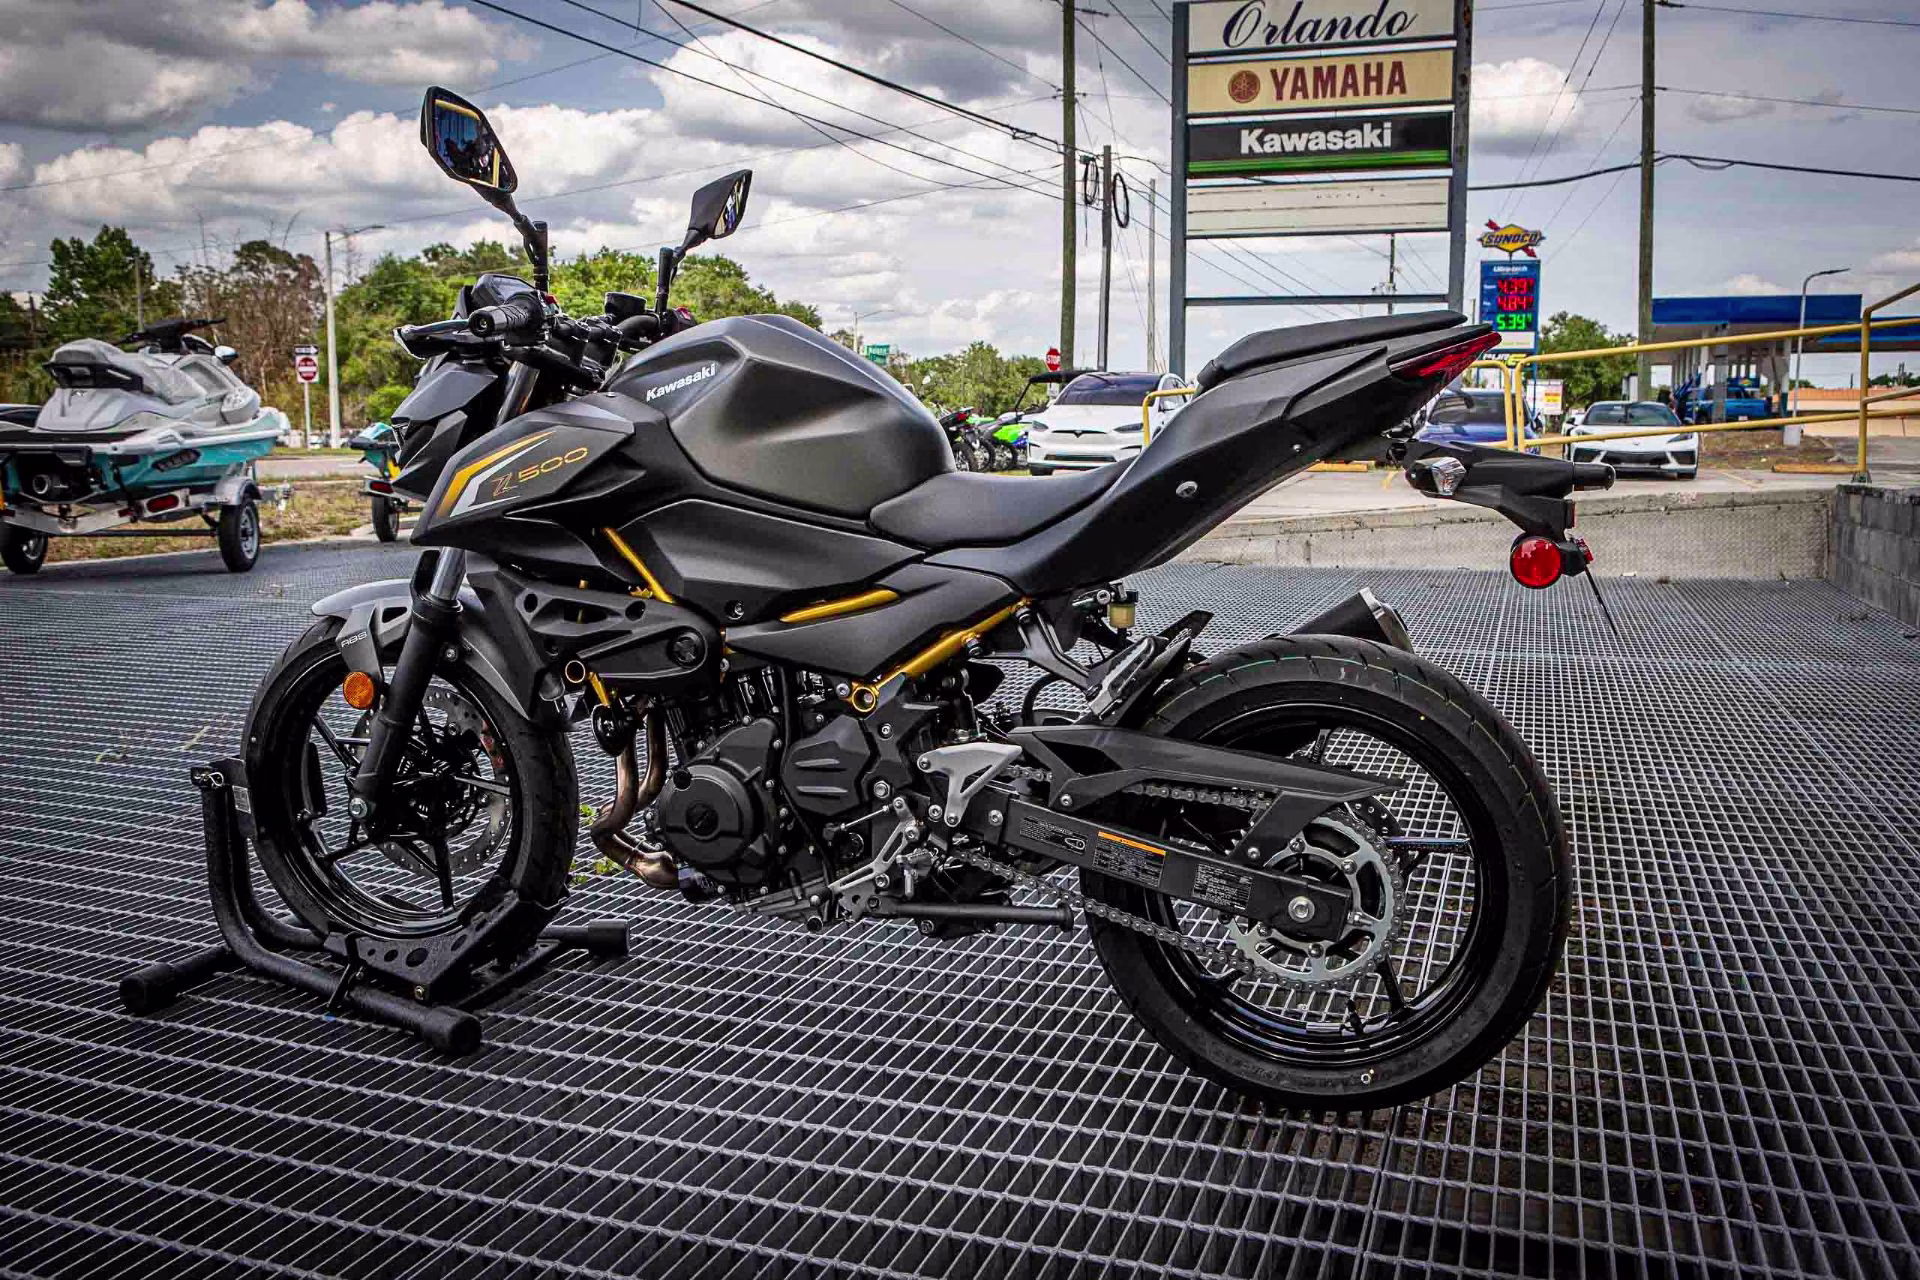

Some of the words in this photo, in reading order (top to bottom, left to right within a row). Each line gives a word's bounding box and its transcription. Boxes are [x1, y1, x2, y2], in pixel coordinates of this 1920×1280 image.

[1223, 0, 1418, 48] Orlando
[1270, 61, 1408, 101] YAMAHA
[1240, 121, 1393, 154] Kawasaki
[1486, 232, 1539, 244] SUNOCO
[1046, 354, 1061, 365] STOP
[646, 363, 717, 402] Kawasaki
[341, 631, 368, 648] ABS
